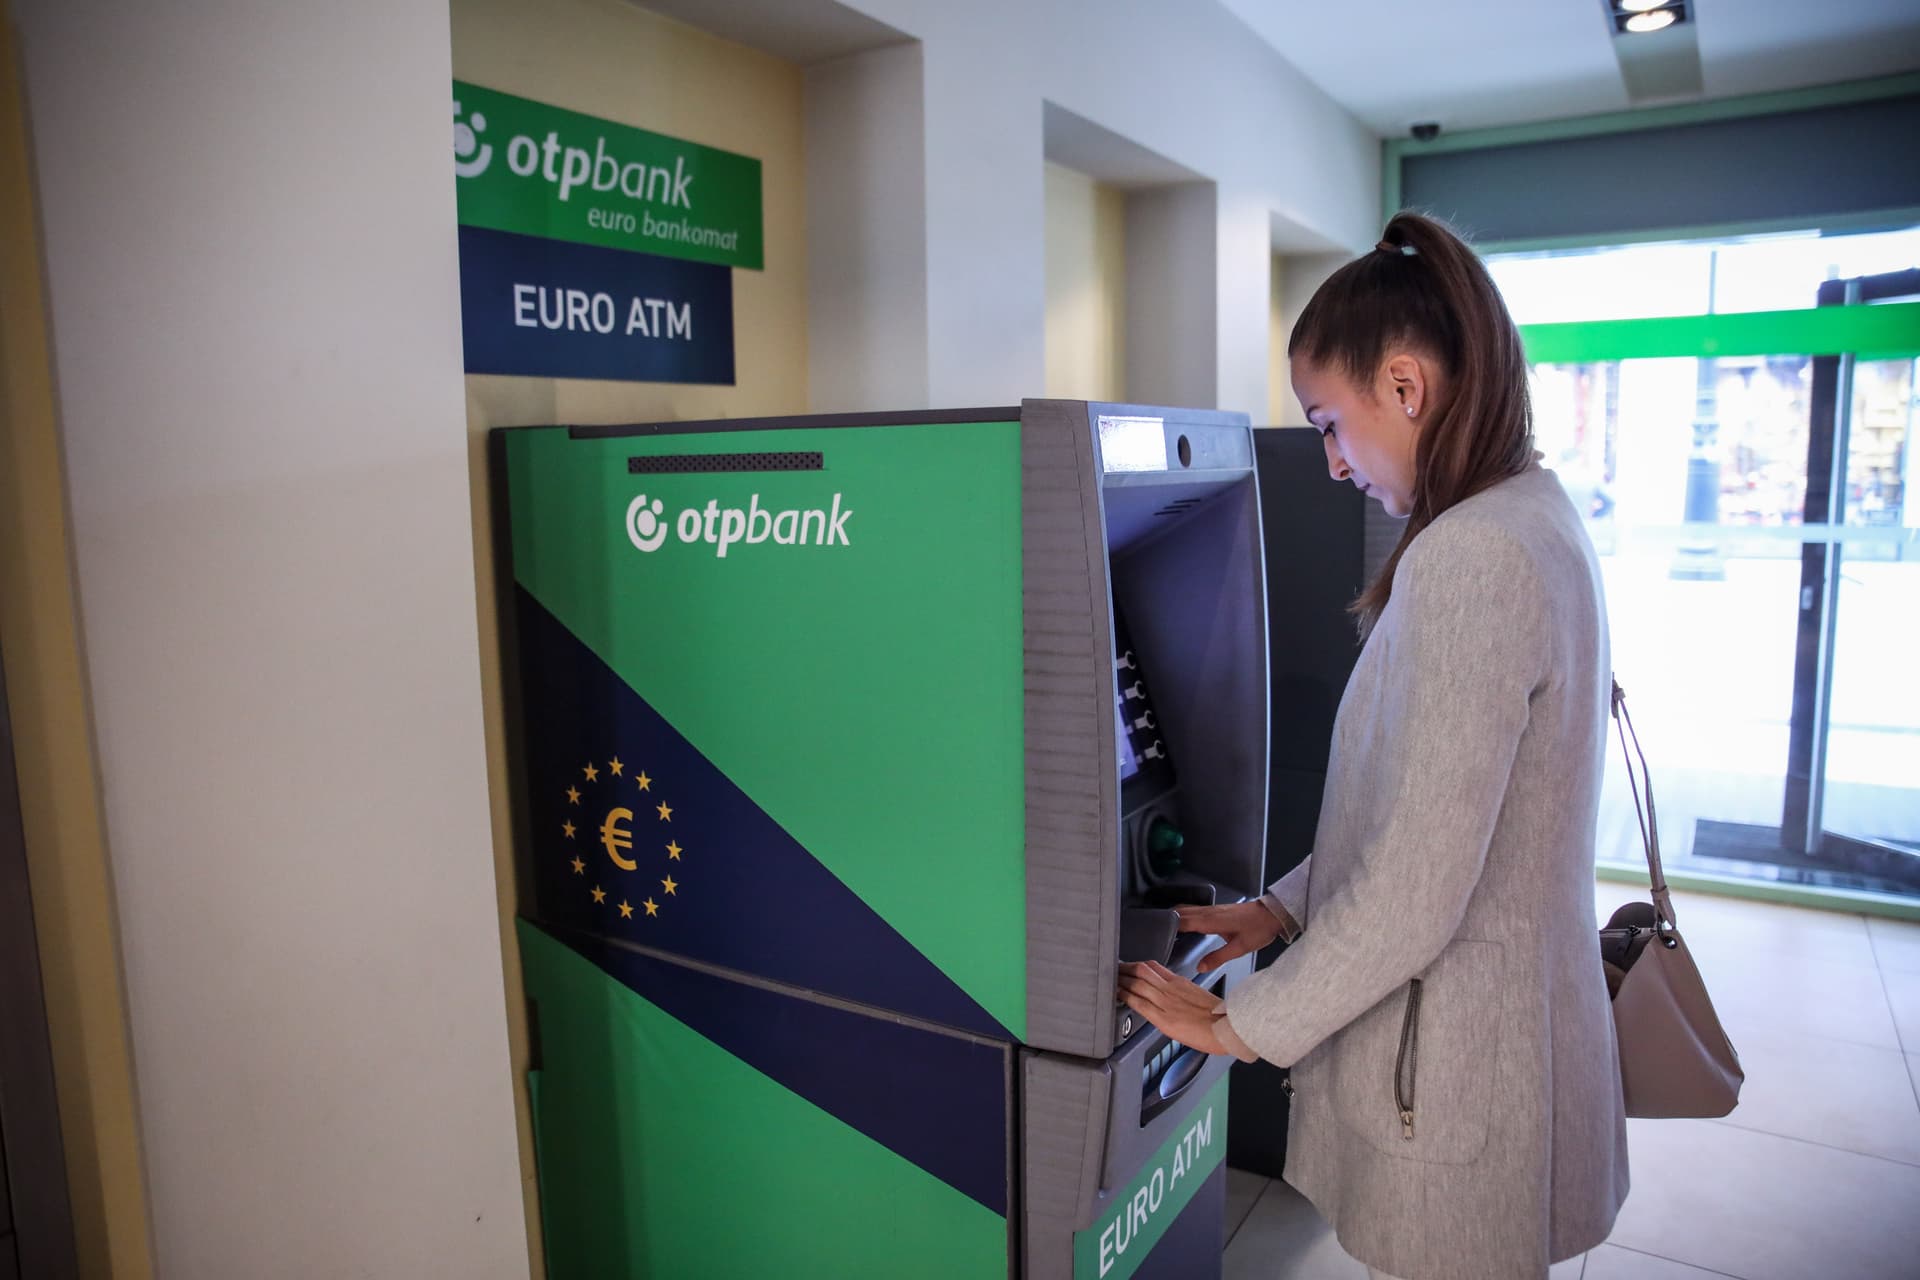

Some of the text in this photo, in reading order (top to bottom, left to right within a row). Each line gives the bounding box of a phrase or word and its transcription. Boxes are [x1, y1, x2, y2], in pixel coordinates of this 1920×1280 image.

[507, 131, 693, 209] otpbank
[587, 208, 738, 251] euro bankomat
[513, 283, 692, 341] EURO ATM
[677, 492, 853, 558] otpbank
[1099, 1107, 1212, 1280] EURO ATM
